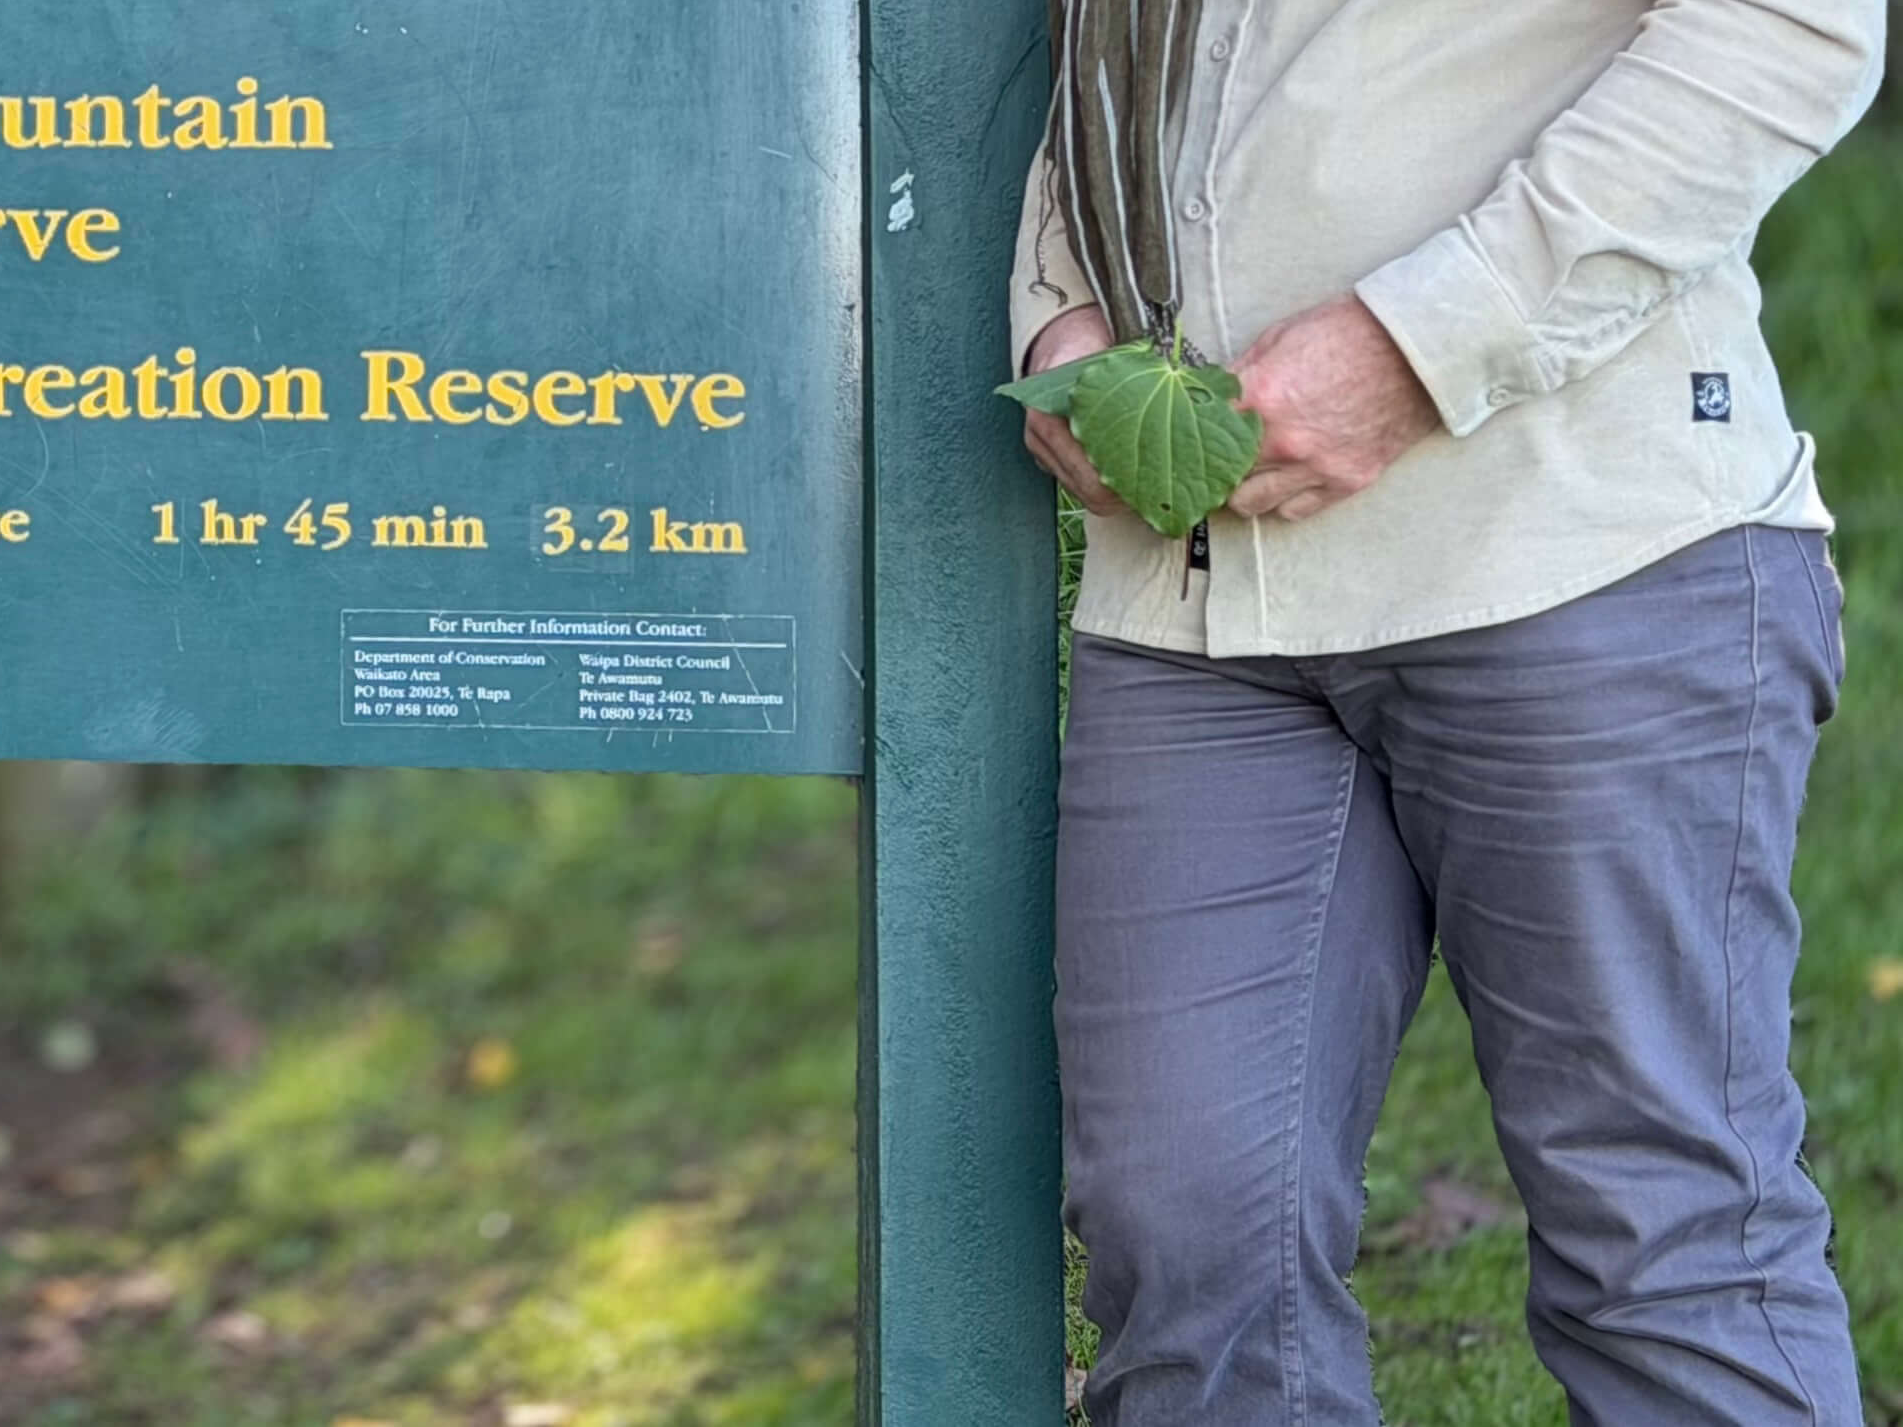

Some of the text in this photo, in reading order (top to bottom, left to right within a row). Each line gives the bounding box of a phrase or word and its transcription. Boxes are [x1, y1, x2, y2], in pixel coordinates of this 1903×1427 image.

[360, 350, 746, 429] Reserve
[151, 500, 180, 544] 1
[200, 498, 266, 546] hr
[283, 498, 353, 550] 45
[371, 506, 488, 548] min
[542, 506, 631, 555] 3.2
[649, 508, 748, 553] km
[429, 617, 707, 637] For Further Information Contact:
[354, 650, 546, 666] Department of Conservation
[579, 653, 730, 670] Waipa District Council
[354, 668, 441, 681] Waikato Area
[579, 672, 662, 685] Te Awamutu
[354, 685, 375, 698] PO
[378, 685, 405, 698] Box
[458, 687, 473, 699] Te
[477, 687, 511, 703] Rapa
[579, 689, 783, 705] Private Bag 2402, Te Awamutu
[354, 703, 458, 717] Ph 07 858 1000
[579, 707, 693, 722] Ph 0800 924 723
